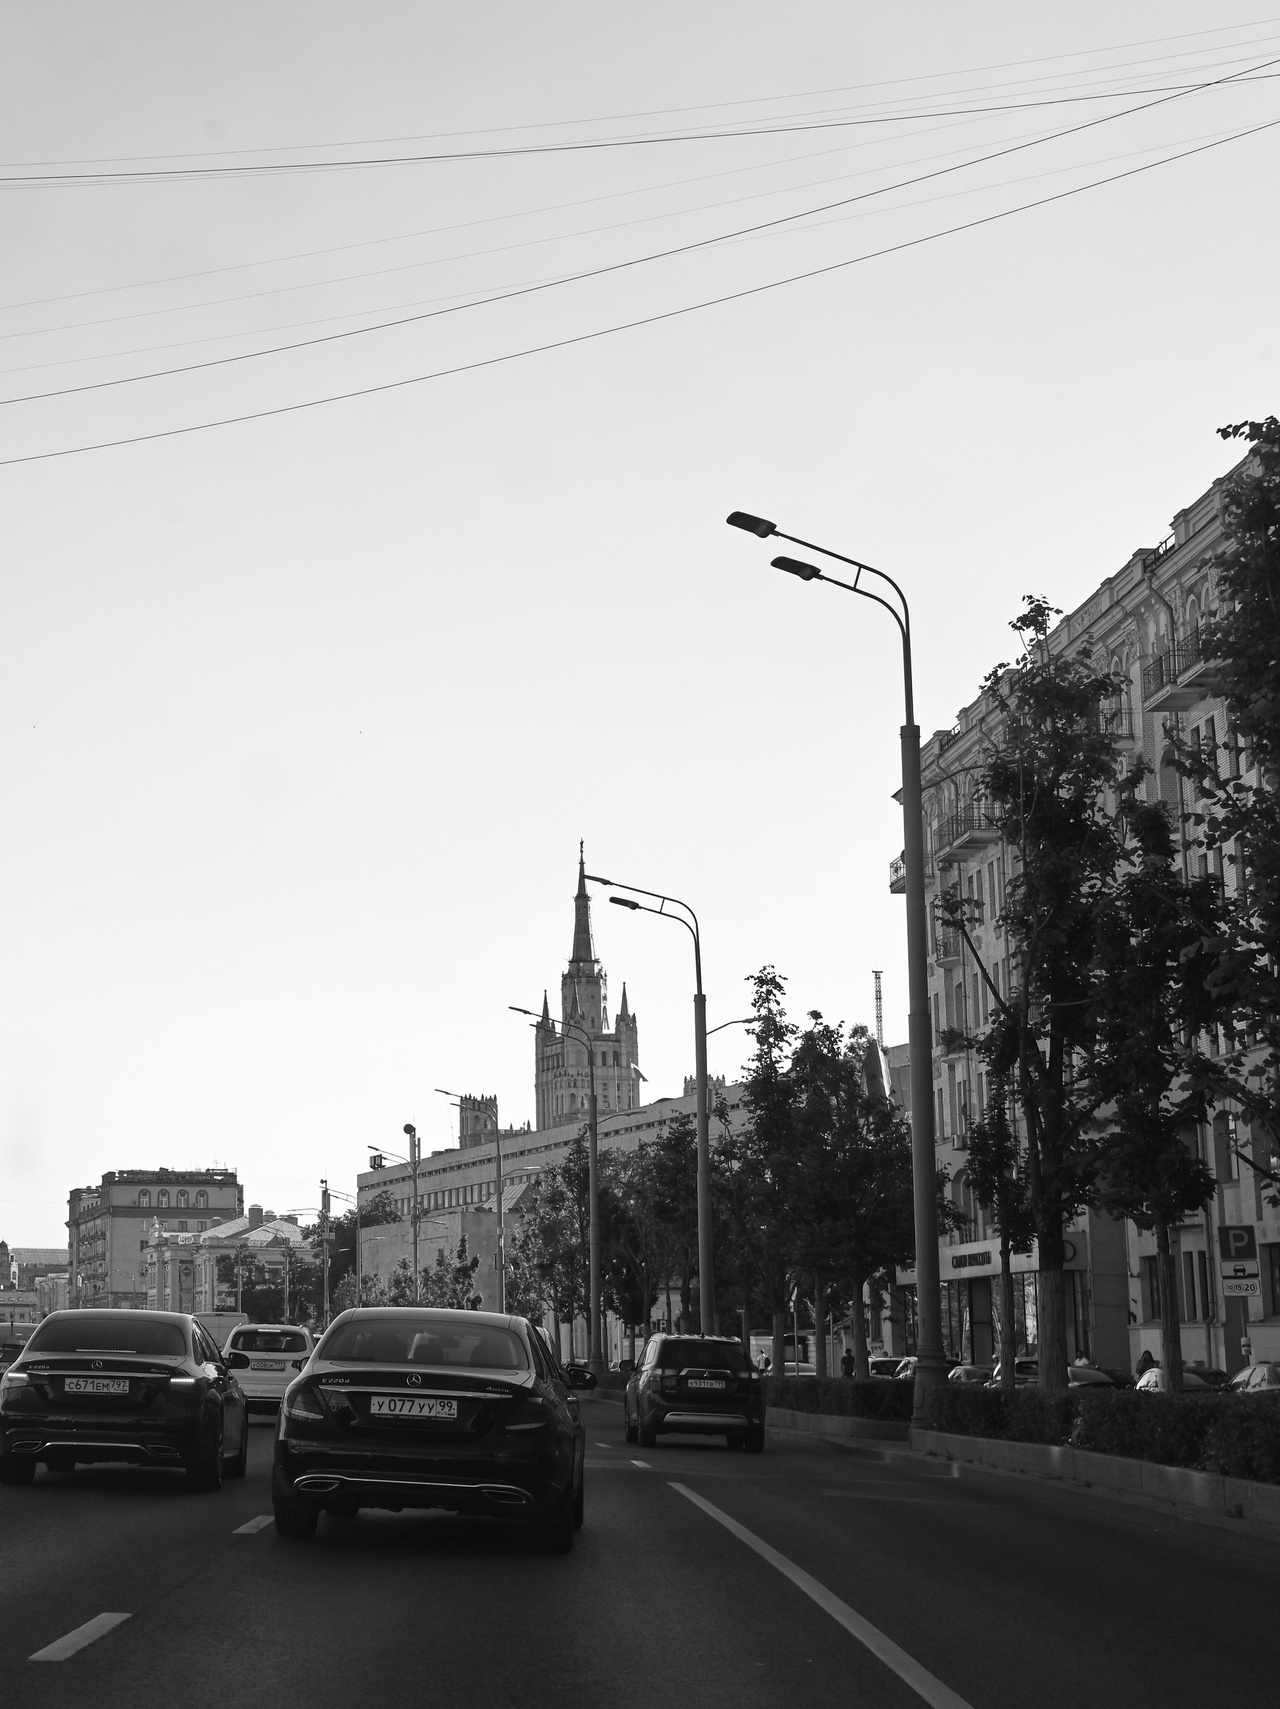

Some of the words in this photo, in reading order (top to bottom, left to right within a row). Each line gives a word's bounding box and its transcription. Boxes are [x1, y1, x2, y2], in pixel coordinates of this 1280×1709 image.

[1228, 1229, 1249, 1257] P
[1244, 1283, 1256, 1292] 20
[68, 1380, 109, 1391] С671ЕМ
[111, 1380, 126, 1389] 797
[439, 1401, 454, 1411] 99
